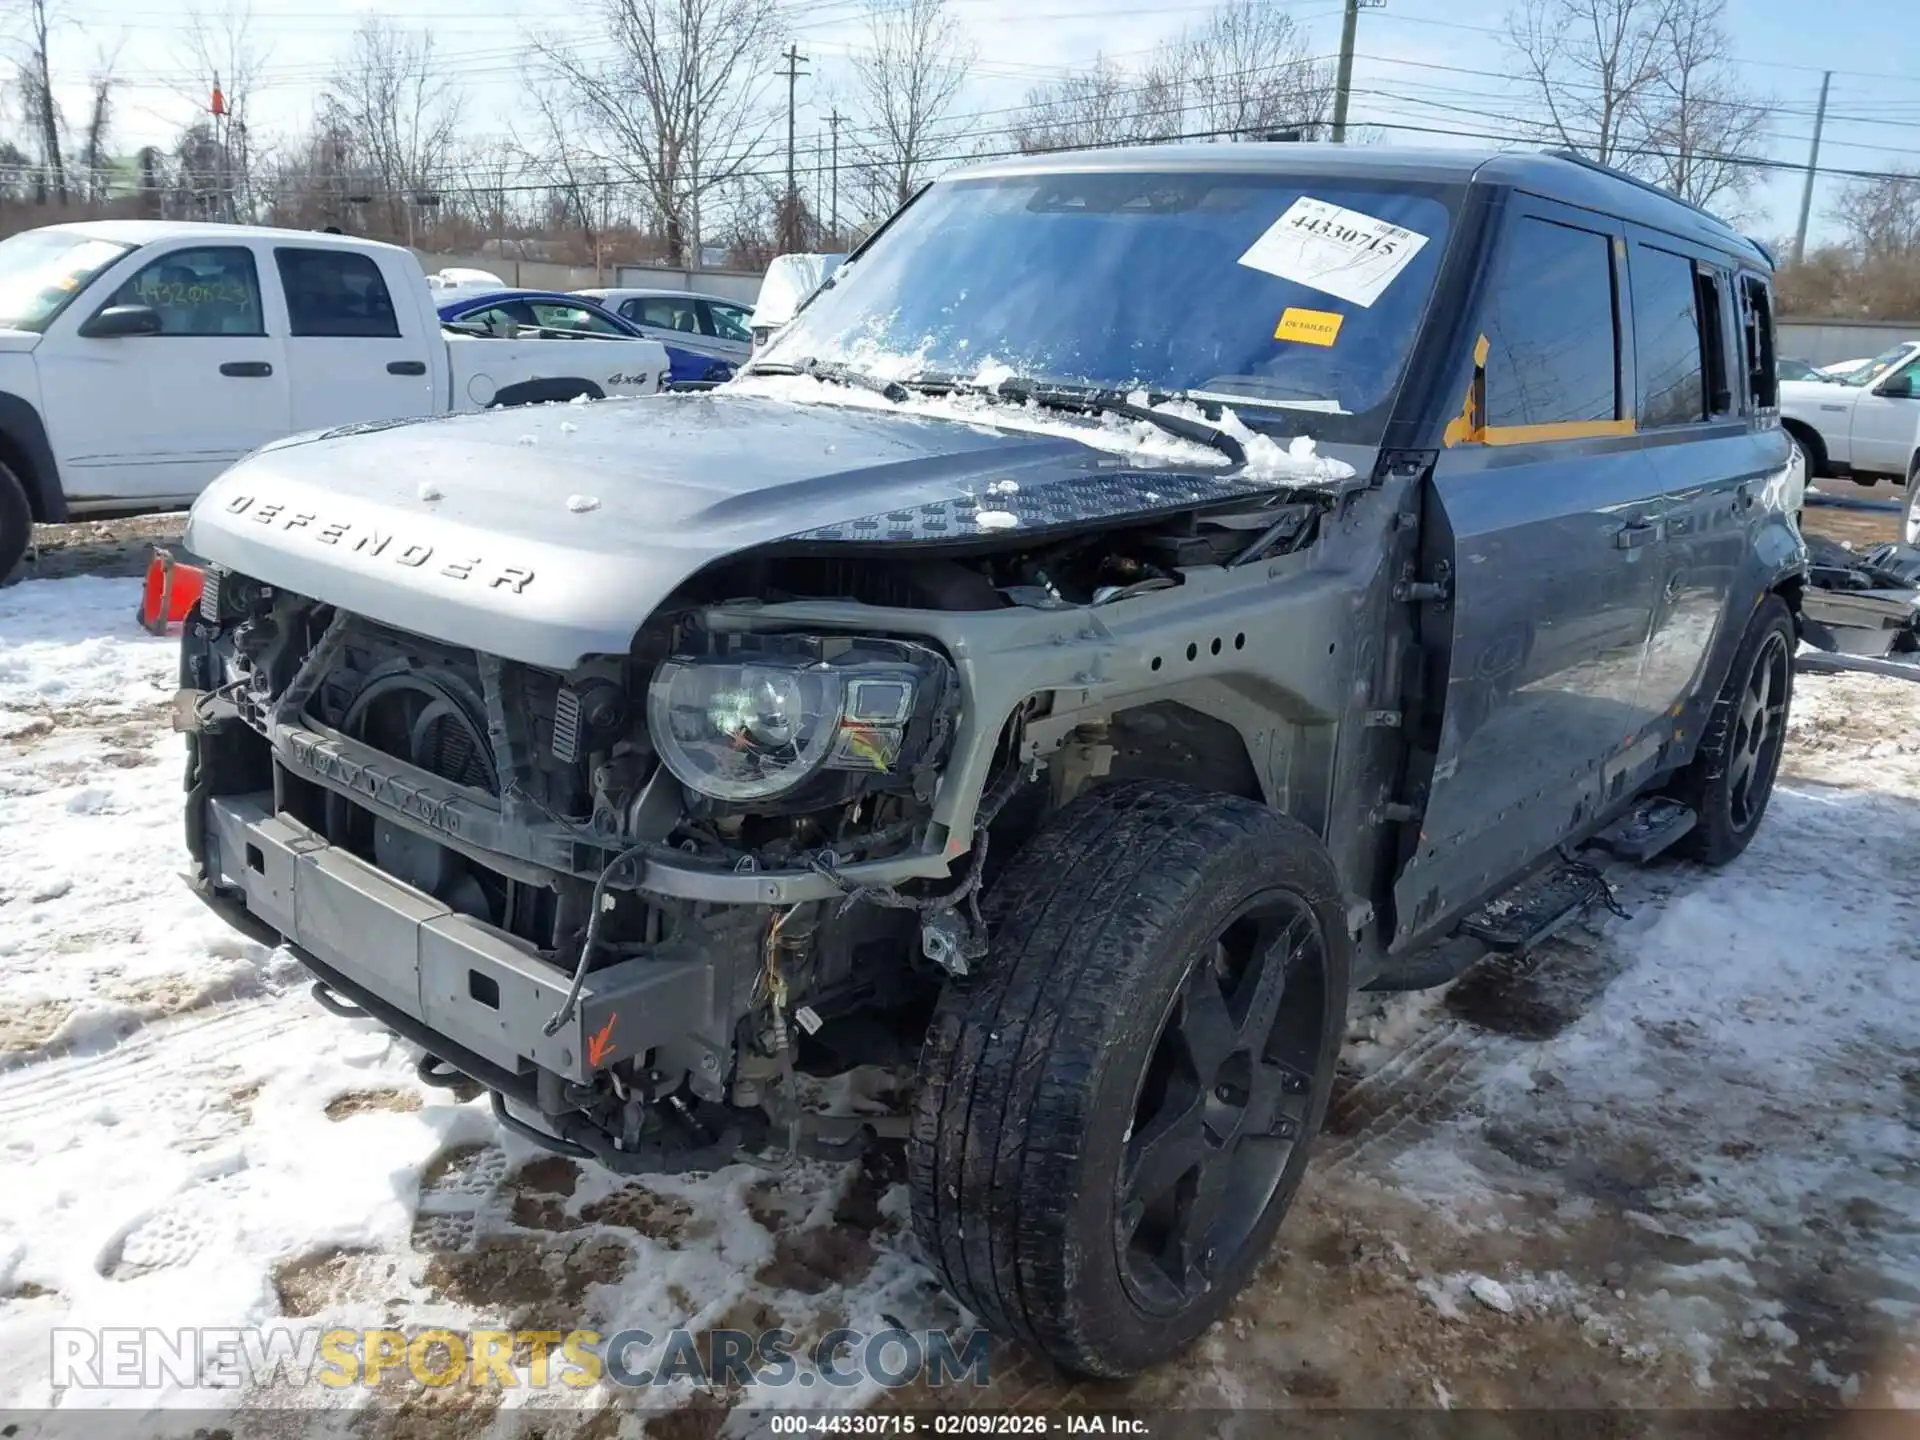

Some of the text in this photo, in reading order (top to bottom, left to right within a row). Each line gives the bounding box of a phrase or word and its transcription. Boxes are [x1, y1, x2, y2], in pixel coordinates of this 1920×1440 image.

[1291, 216, 1398, 255] 44330715
[608, 372, 648, 385] 4x4
[226, 495, 536, 594] DEFENDER
